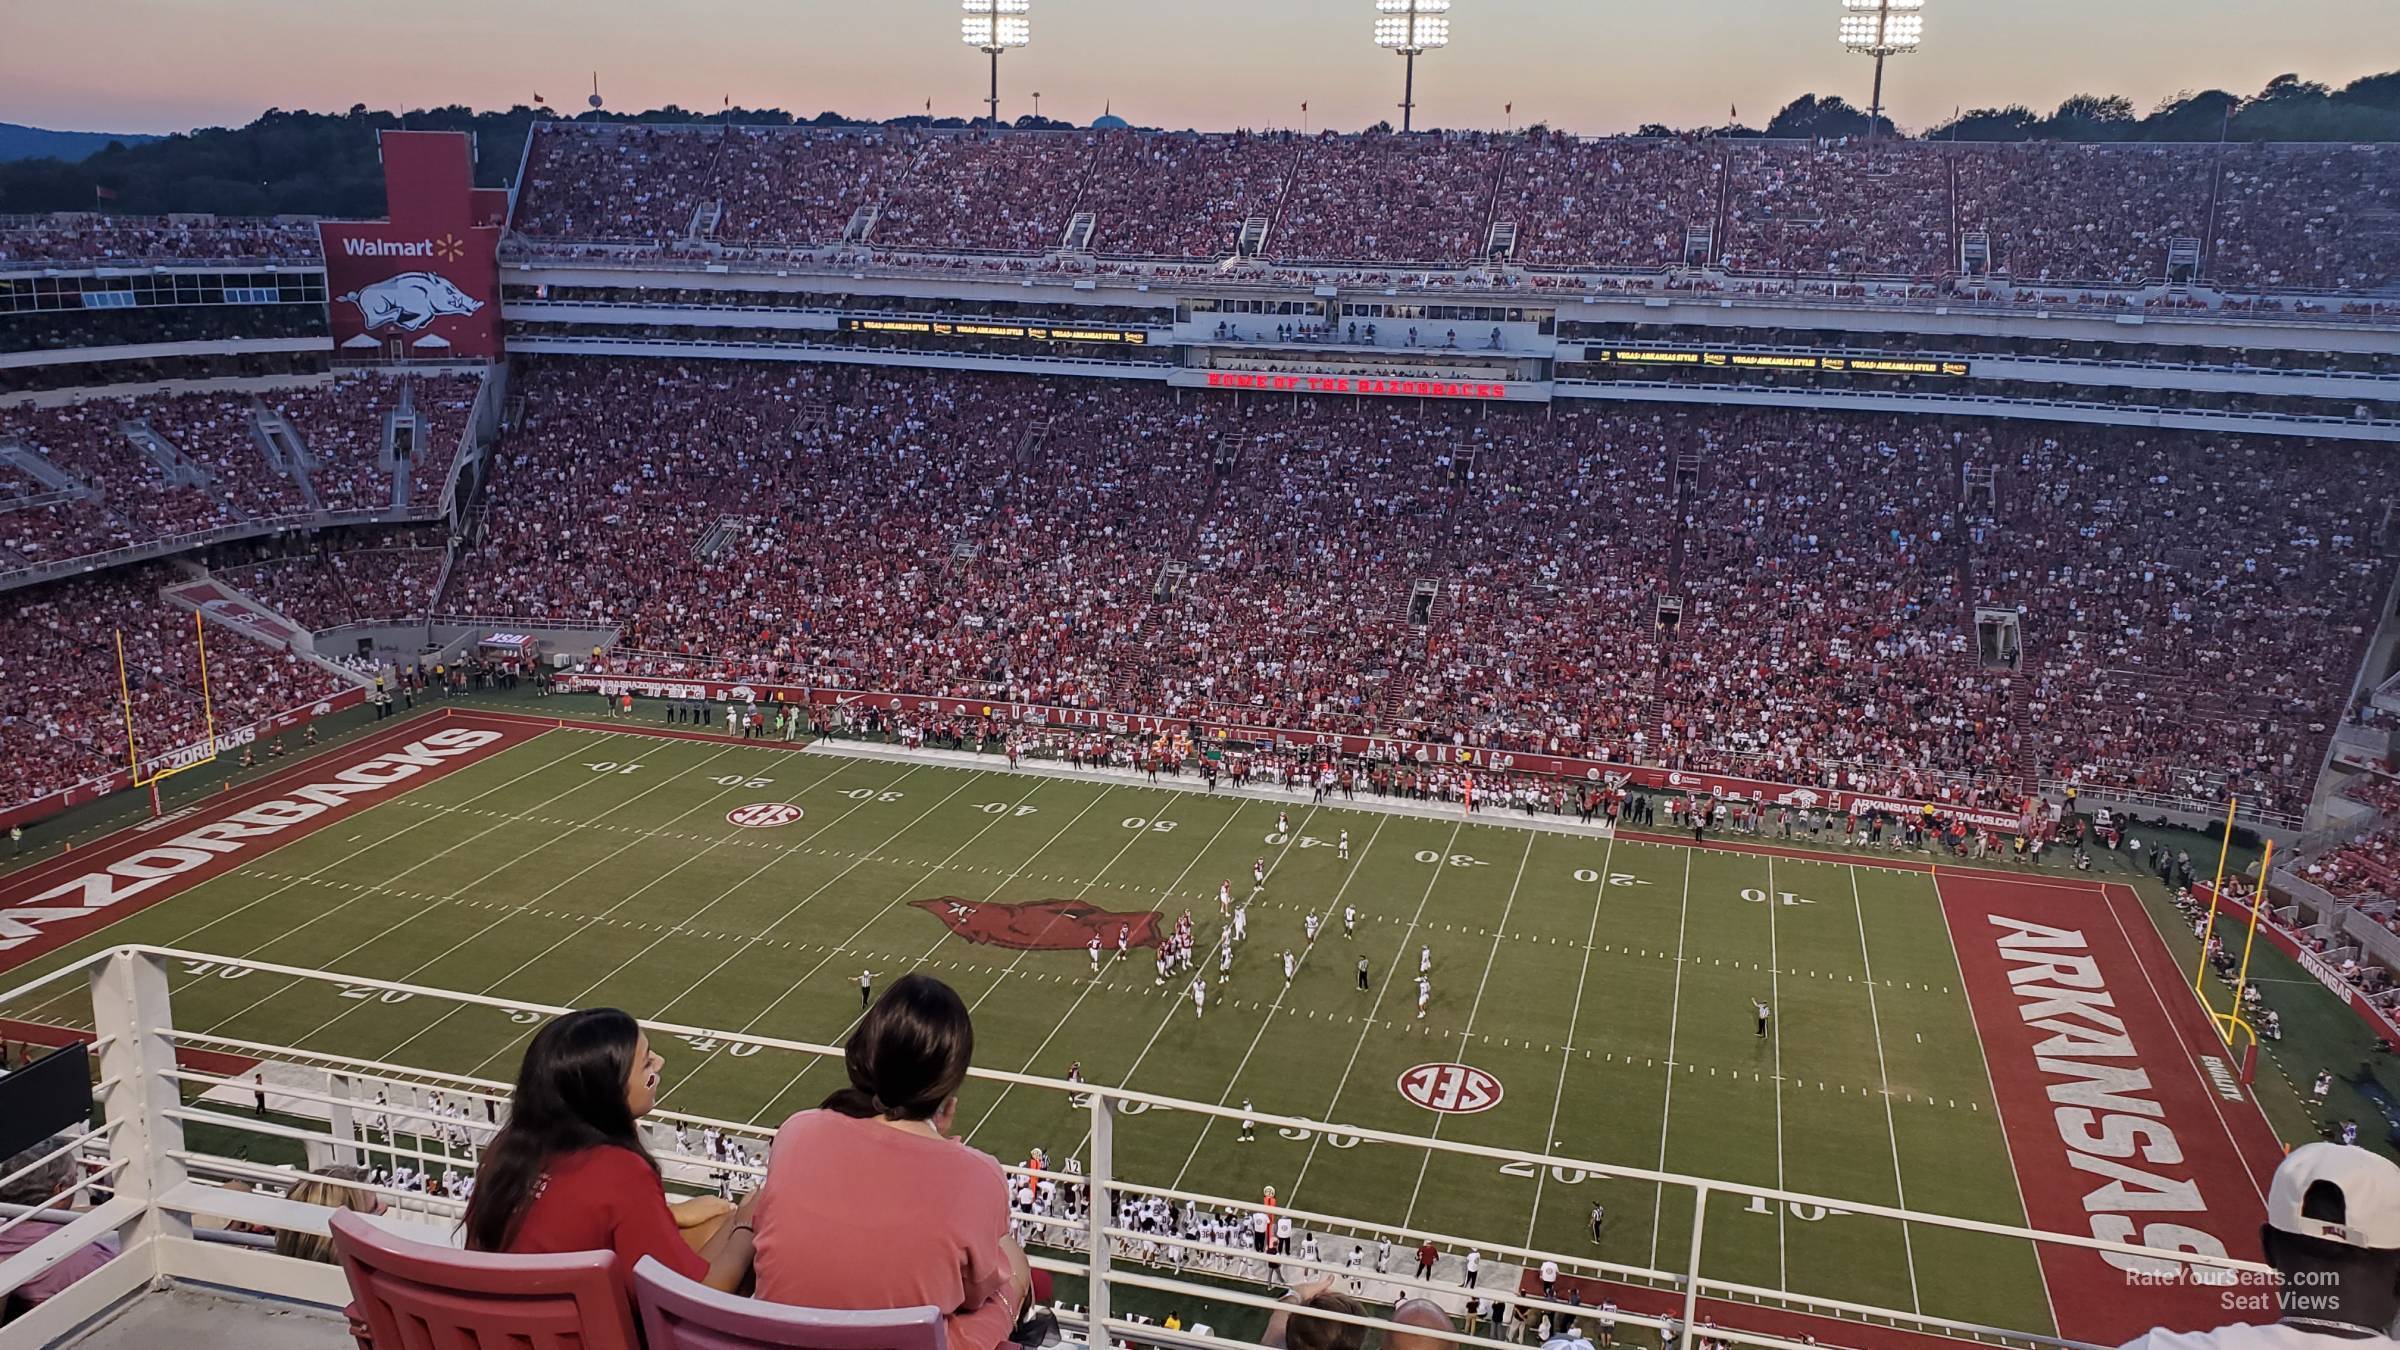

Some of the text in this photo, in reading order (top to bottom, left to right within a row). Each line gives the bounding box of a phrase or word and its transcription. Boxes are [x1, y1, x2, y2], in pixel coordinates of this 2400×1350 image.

[343, 238, 434, 257] Walmart
[1641, 352, 1676, 361] ARKANSAS
[1757, 357, 1792, 366] ARKANSAS
[1876, 361, 1913, 371] ARKANSAS
[1207, 372, 1506, 398] HOME OF THE RAZORBACKS
[591, 761, 645, 774] 10
[717, 775, 775, 789] 20
[848, 788, 904, 801] 30
[732, 804, 799, 826] SEC
[982, 802, 1038, 816] 40
[1122, 817, 1178, 832] 50
[1264, 833, 1323, 848] 40
[1414, 850, 1475, 867] 30
[1573, 869, 1636, 887] 20
[1740, 888, 1799, 906] 10
[2297, 950, 2353, 1005] ARKANSAS
[1403, 1064, 1495, 1111] SEC
[1987, 914, 2240, 1285] ARKANSAS
[1068, 1160, 1079, 1173] 12
